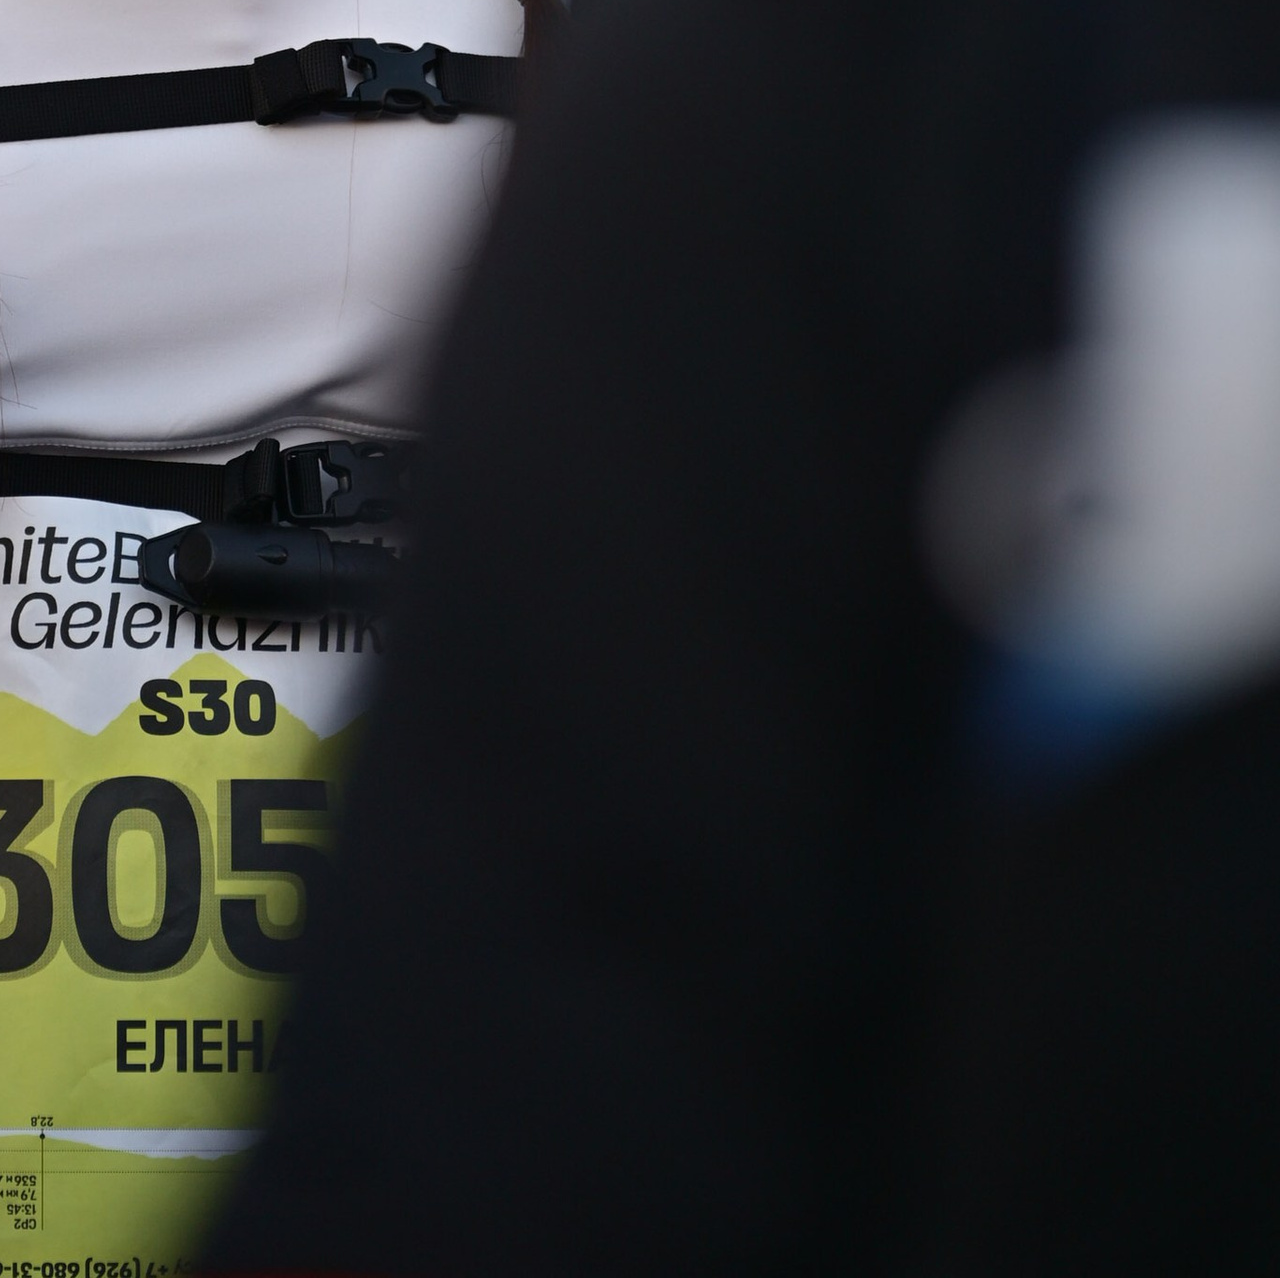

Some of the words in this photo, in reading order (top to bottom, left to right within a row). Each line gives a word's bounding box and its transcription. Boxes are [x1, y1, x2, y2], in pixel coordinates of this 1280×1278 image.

[139, 679, 277, 736] S30
[30, 1115, 54, 1127] 22,8
[14, 1174, 37, 1186] 536
[20, 1188, 37, 1200] 7,9
[7, 1204, 37, 1214] 13:45
